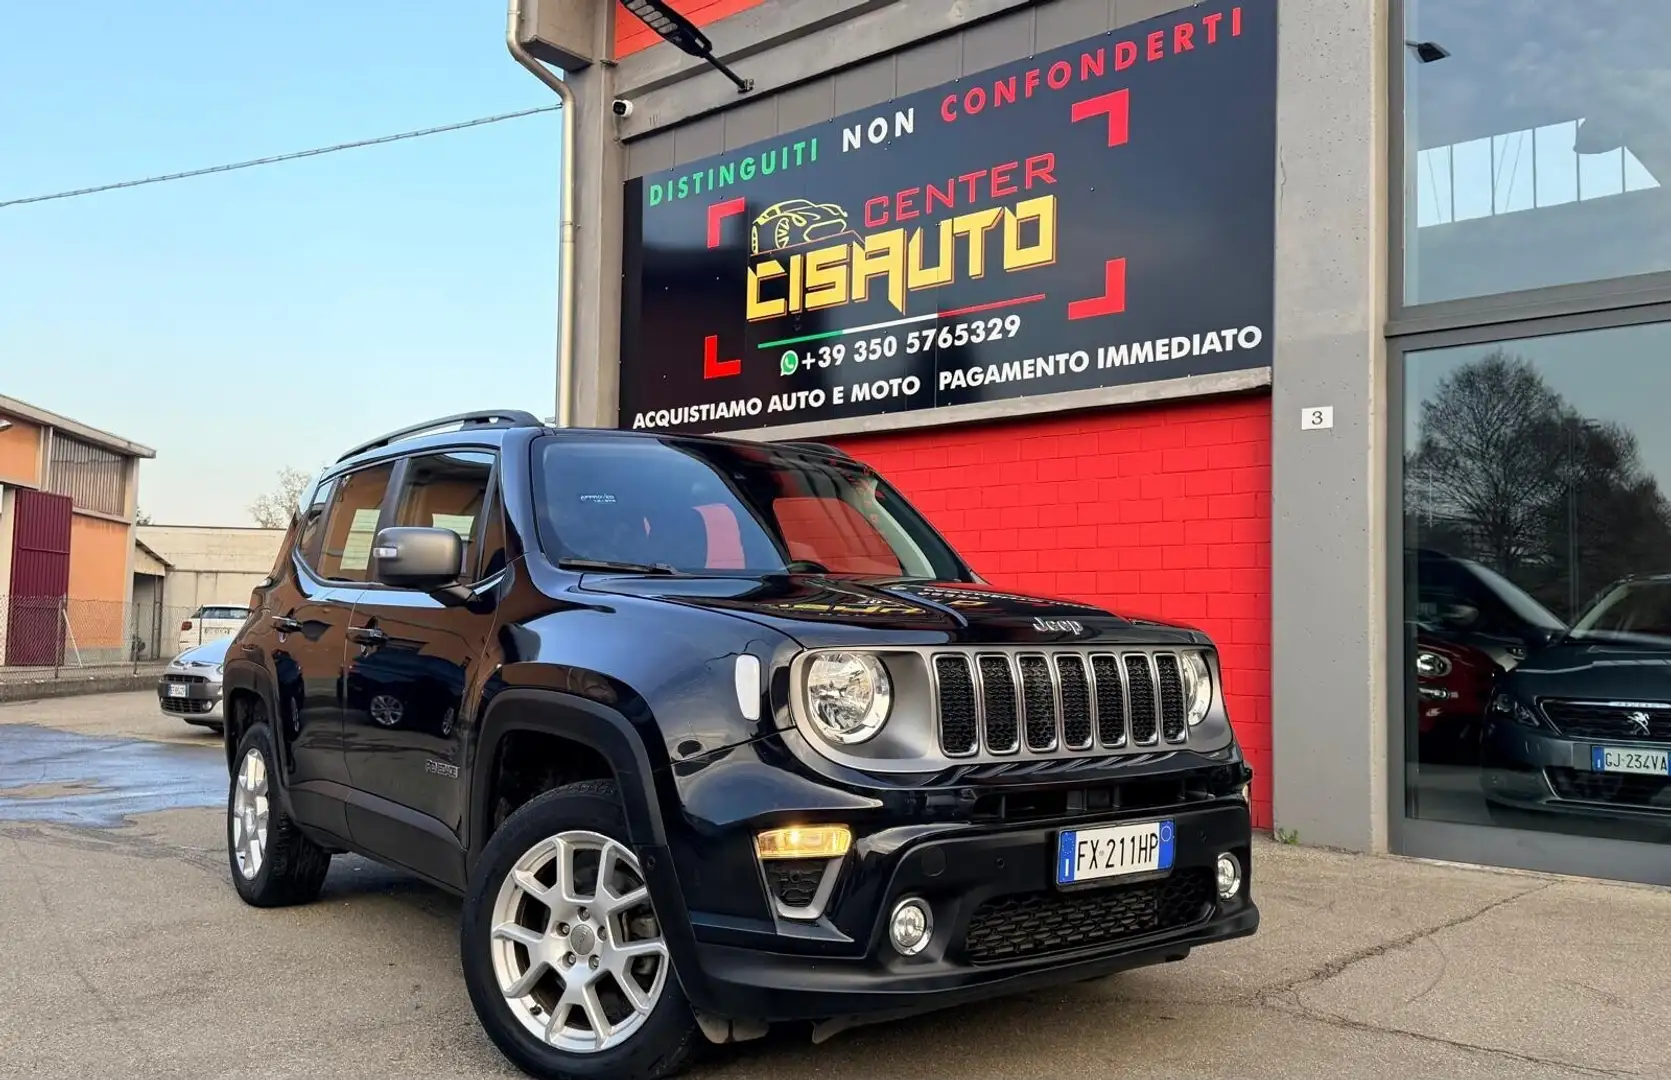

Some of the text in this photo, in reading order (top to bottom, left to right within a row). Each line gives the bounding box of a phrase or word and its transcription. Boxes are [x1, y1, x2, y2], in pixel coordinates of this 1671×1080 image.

[650, 7, 1242, 207] DISTINGUITI NON CONFONDERTI
[865, 152, 1058, 228] CENTER
[746, 194, 1057, 322] CISAUTO
[801, 314, 1021, 371] +39 350 5765329
[632, 325, 1263, 430] ACQUISTIAMO AUTO E MOTO PAGAMENTO IMMEDIATO
[1311, 410, 1323, 425] 3
[1032, 616, 1084, 635] Jeep
[1605, 752, 1621, 768] GJ
[1626, 753, 1668, 771] 234VA
[1077, 839, 1100, 871] FX
[1104, 832, 1159, 869] 211HP
